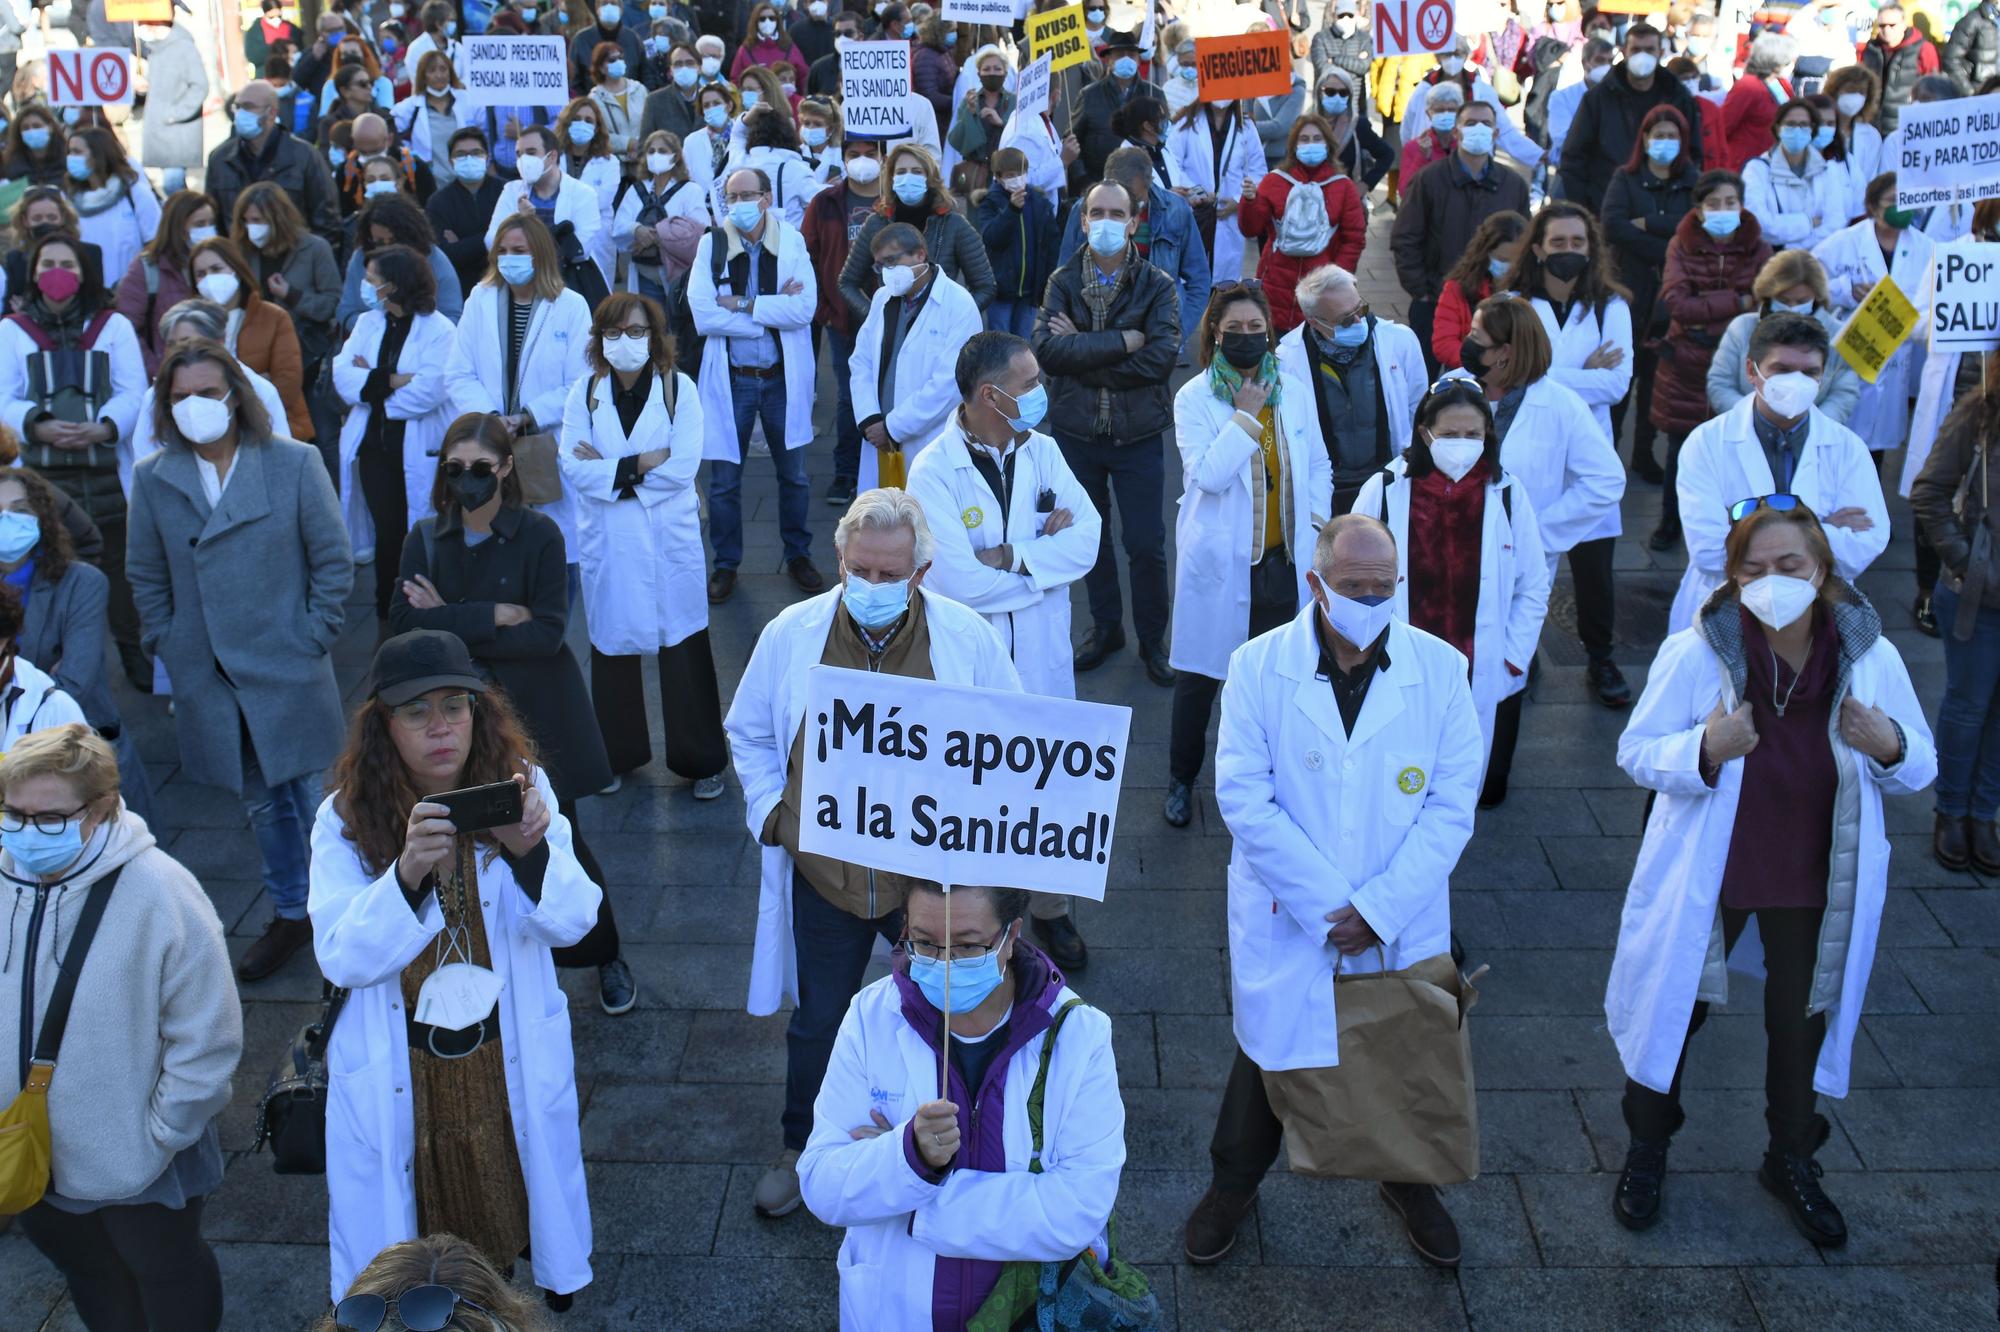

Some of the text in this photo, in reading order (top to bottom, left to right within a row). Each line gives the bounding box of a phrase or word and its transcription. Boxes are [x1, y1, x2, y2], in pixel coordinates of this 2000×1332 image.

[950, 2, 958, 10] no
[1376, 0, 1453, 54] NO
[511, 44, 560, 64] PREVENTIVA,
[844, 50, 907, 70] RECORTES
[1199, 46, 1281, 88] ¡VERGÜENZA!
[49, 51, 128, 102] NO
[470, 71, 563, 88] PENSADA PARA TODOS!
[846, 78, 908, 98] EN SANIDAD
[847, 106, 910, 126] MATAN.
[1903, 117, 1960, 146] ¡SANIDAD
[1902, 141, 2000, 172] DE y PARA TOD
[1899, 188, 1952, 206] Recortes
[1979, 181, 2000, 197] mat
[1936, 254, 1993, 292] ¡Por
[1935, 302, 1999, 332] SALU
[817, 698, 1117, 790] ¡Más apoyos
[816, 786, 1111, 865] a la Sanidad!
